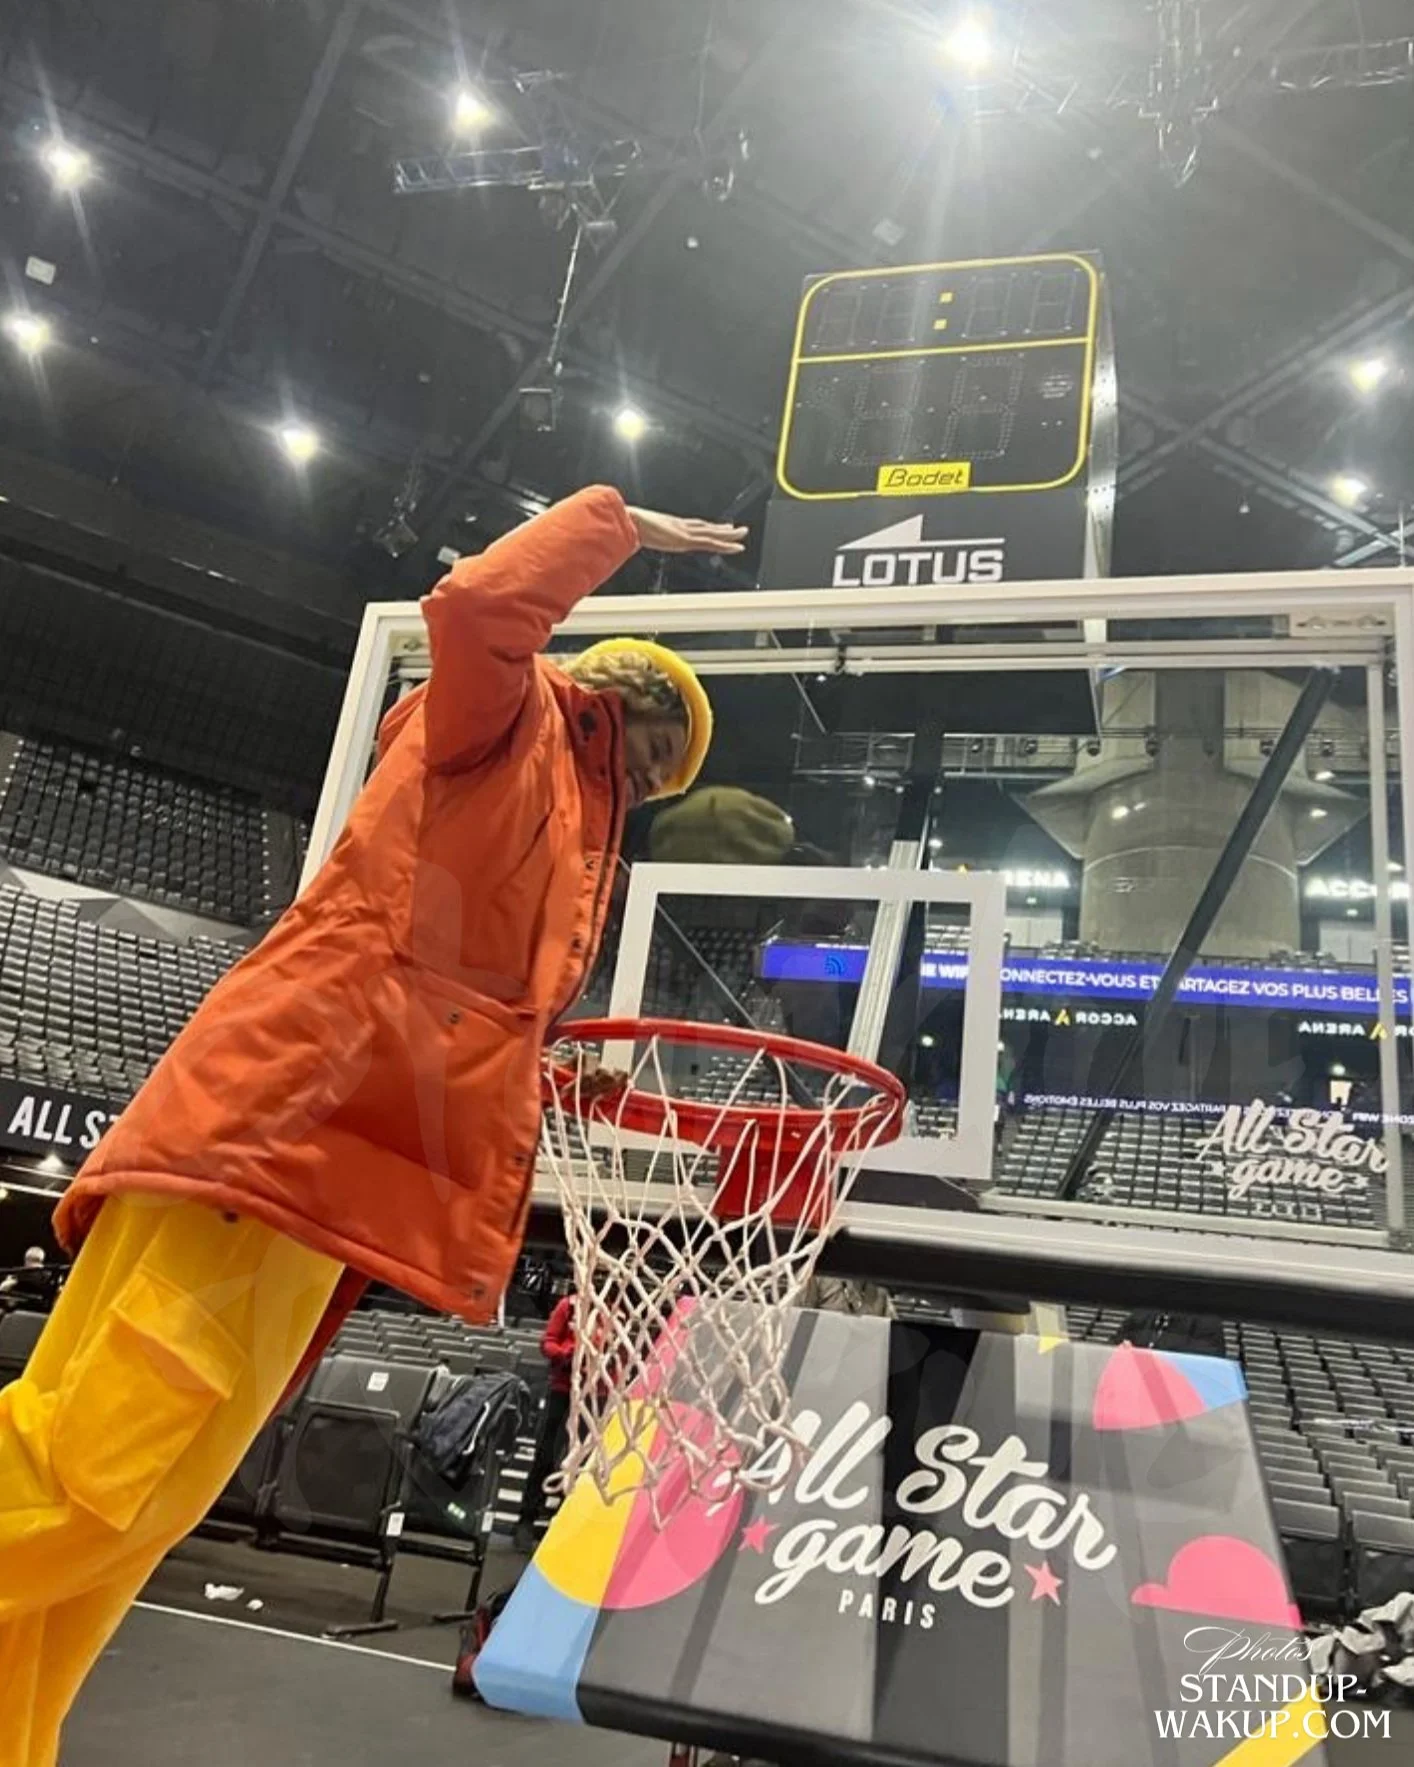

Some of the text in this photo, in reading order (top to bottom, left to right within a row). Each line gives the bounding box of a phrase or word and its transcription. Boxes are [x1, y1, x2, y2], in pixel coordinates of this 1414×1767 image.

[885, 468, 963, 489] Bodet
[832, 550, 1005, 587] LOTUS
[1000, 967, 1136, 989] ONNECTEZ-VOUS
[1254, 982, 1289, 997] VOS
[1292, 983, 1338, 999] PLUS
[7, 1095, 72, 1145] ALL
[1193, 1098, 1390, 1173] All Star
[1227, 1157, 1347, 1201] game
[896, 1424, 1118, 1570] Star
[754, 1518, 1015, 1608] game
[837, 1589, 937, 1629] PARIS
